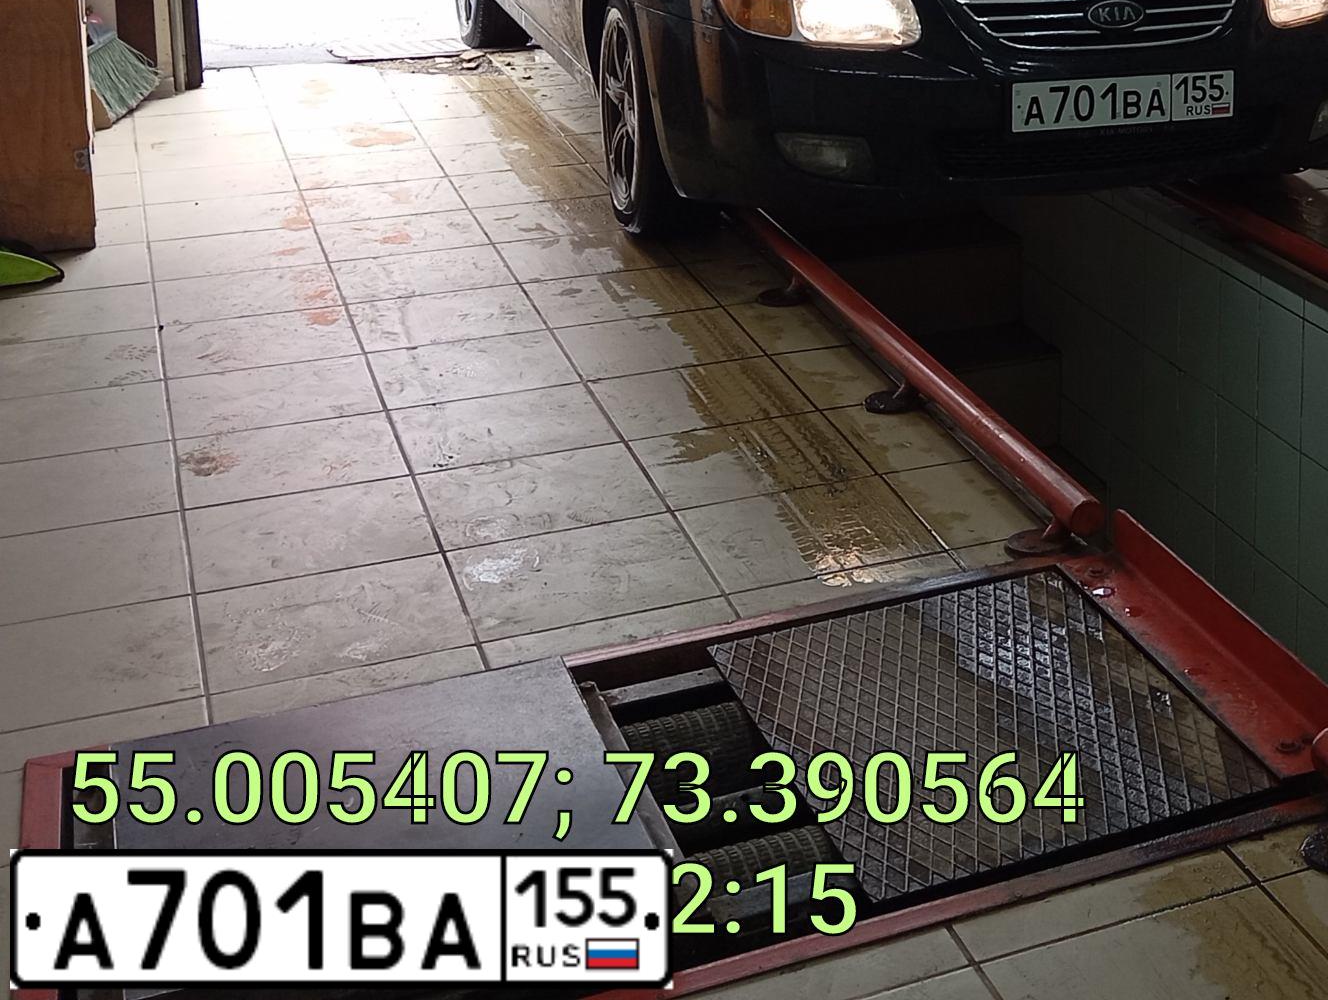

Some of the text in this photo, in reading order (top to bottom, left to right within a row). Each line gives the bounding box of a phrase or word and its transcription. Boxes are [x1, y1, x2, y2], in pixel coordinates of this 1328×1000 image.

[1098, 5, 1135, 23] KIA
[1174, 74, 1226, 105] 155
[1023, 82, 1167, 126] А701ВА
[1185, 105, 1212, 116] RUS
